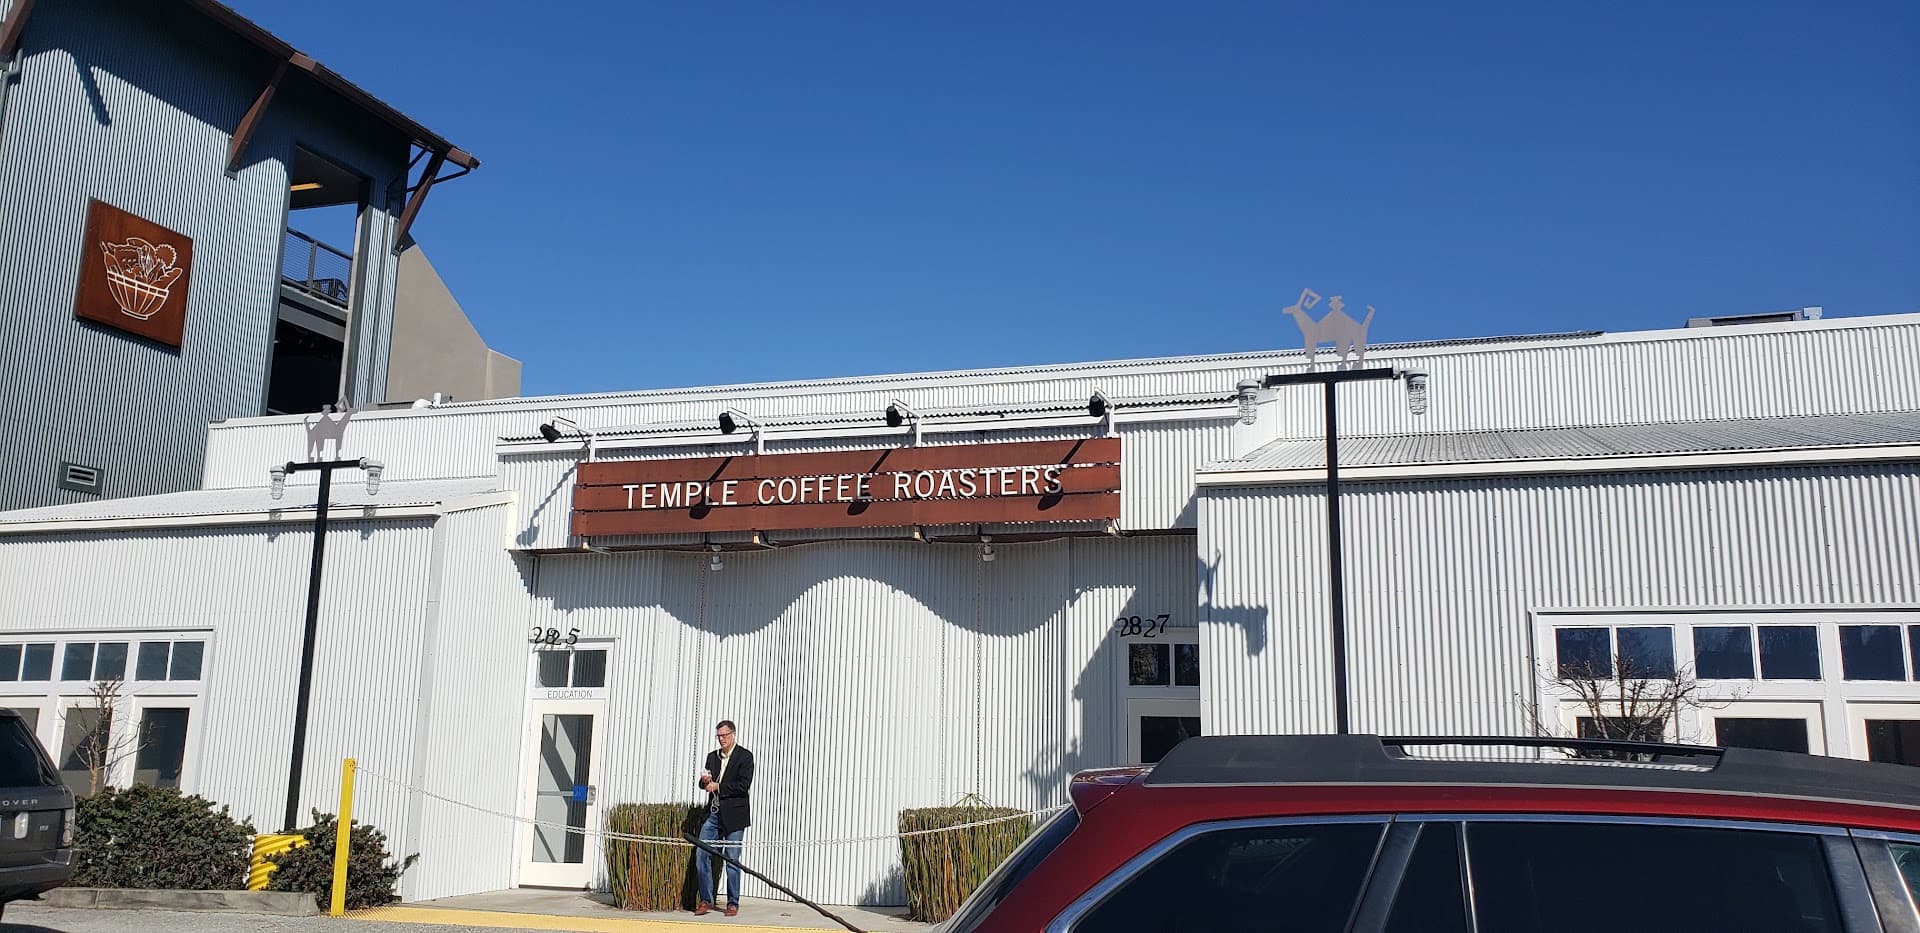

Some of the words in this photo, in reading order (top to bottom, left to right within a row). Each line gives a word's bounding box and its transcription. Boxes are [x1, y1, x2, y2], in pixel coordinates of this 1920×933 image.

[622, 480, 739, 510] TEMPLE
[757, 473, 873, 505] COFFEE
[893, 467, 1062, 499] ROASTERS
[531, 626, 580, 645] 2825
[1116, 613, 1171, 638] 2827
[547, 690, 593, 699] EDUCATION
